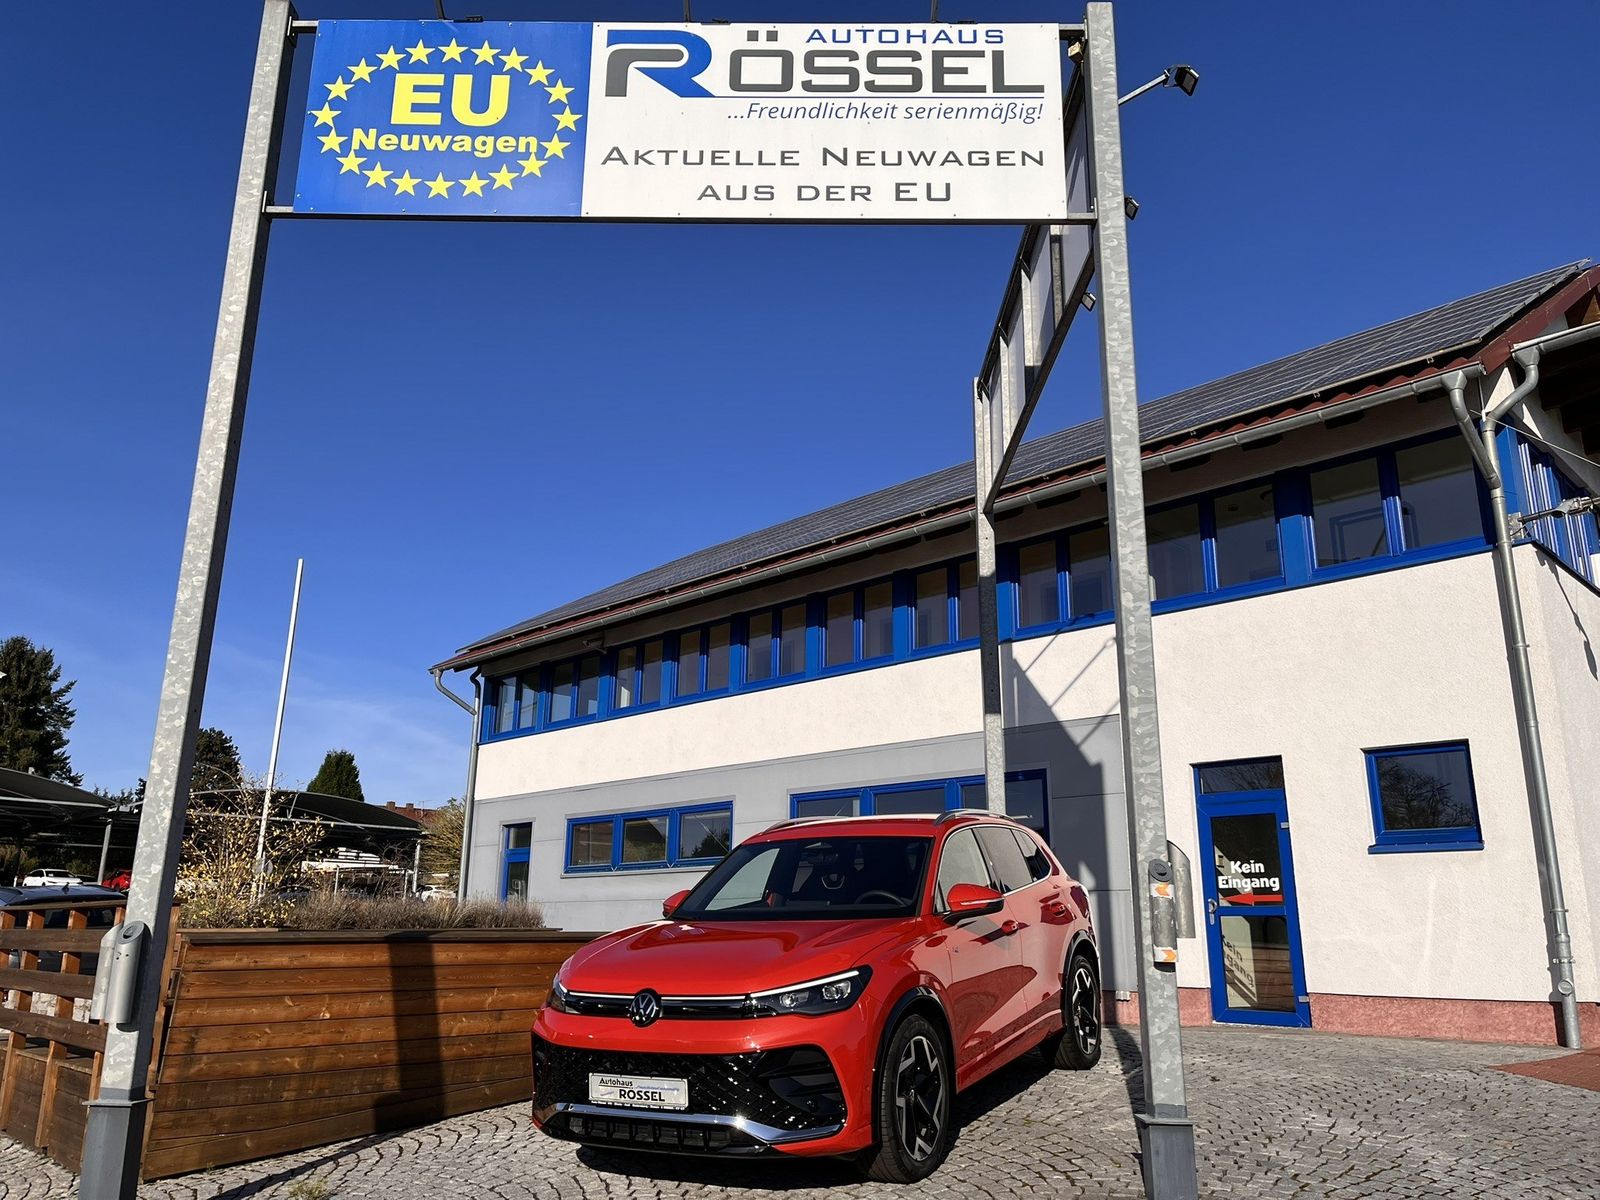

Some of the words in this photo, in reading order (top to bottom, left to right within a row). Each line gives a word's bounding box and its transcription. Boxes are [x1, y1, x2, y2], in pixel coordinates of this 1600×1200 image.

[806, 28, 1004, 44] AUTOHAUS
[605, 29, 1045, 98] RÖSSEL
[390, 73, 511, 127] EU
[904, 102, 1044, 125] serienmäßig!
[351, 128, 538, 158] Neuwagen
[697, 184, 775, 202] AUS
[797, 185, 873, 202] DER
[895, 182, 952, 202] EU
[1230, 860, 1265, 874] Kein
[1217, 875, 1280, 891] Eingang
[599, 1077, 633, 1087] Autohaus
